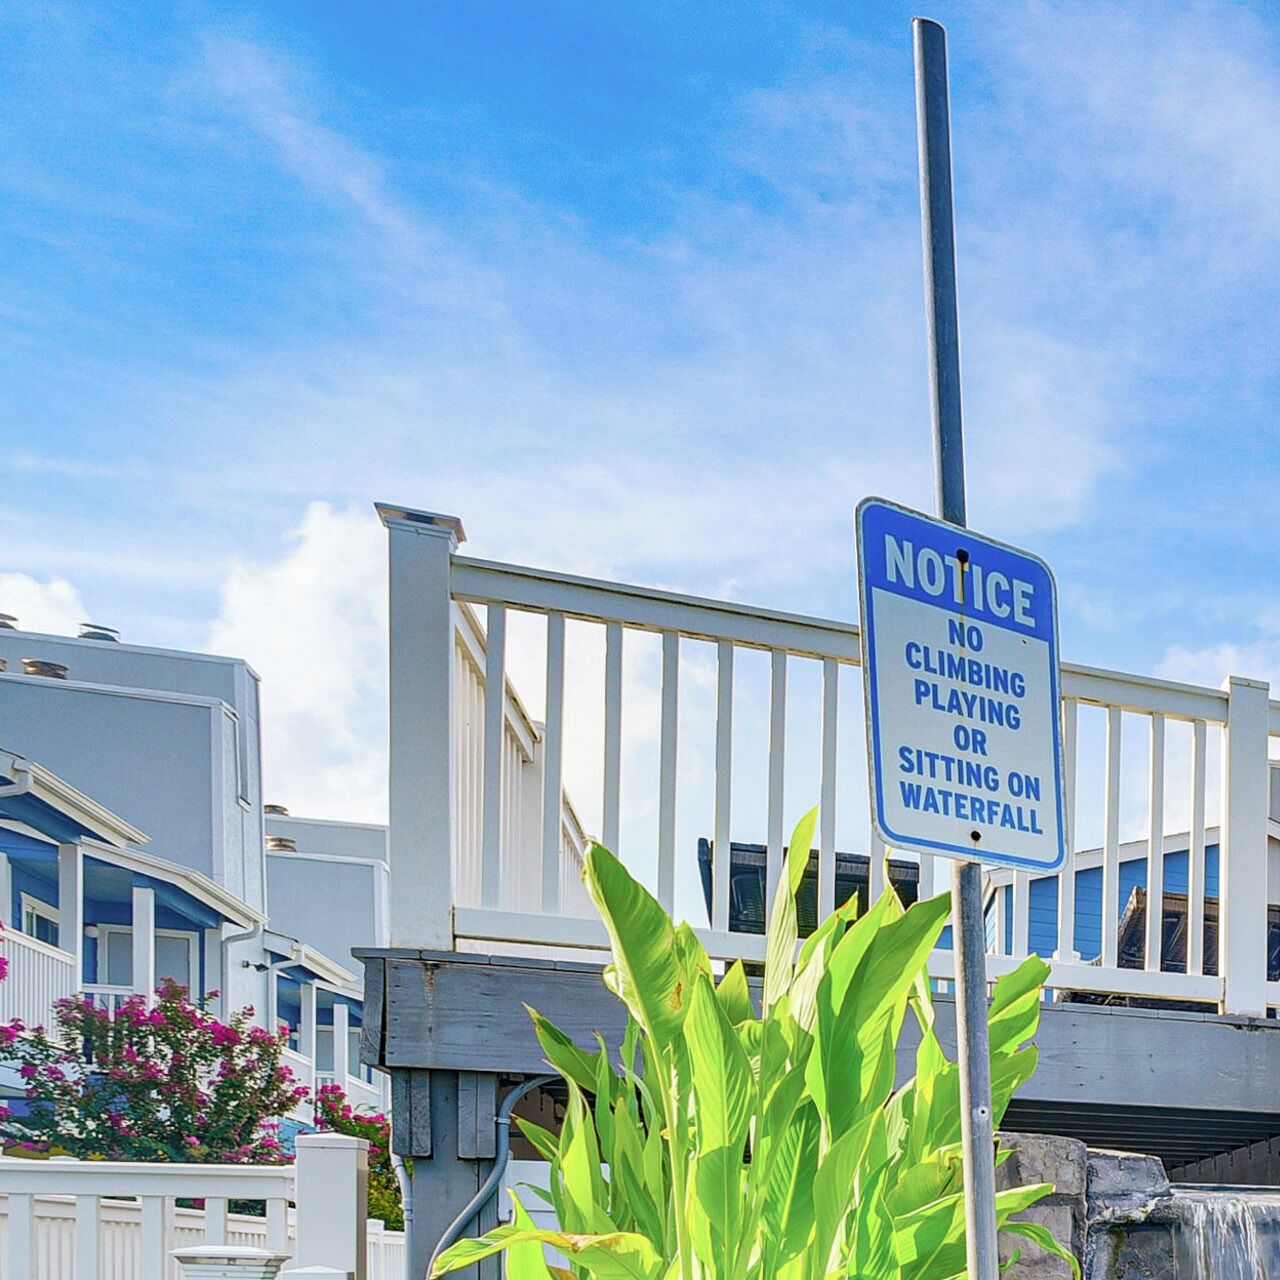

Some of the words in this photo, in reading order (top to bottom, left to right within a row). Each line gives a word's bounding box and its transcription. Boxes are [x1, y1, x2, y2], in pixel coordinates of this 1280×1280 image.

[884, 533, 1036, 628] NOTICE
[948, 618, 984, 652] NO
[905, 641, 1026, 698] CLIMBING
[914, 679, 1021, 730] PLAYING
[953, 724, 987, 756] OR
[898, 746, 1000, 792] SITTING
[1008, 771, 1040, 802] ON
[899, 781, 1044, 835] WATERFALL
